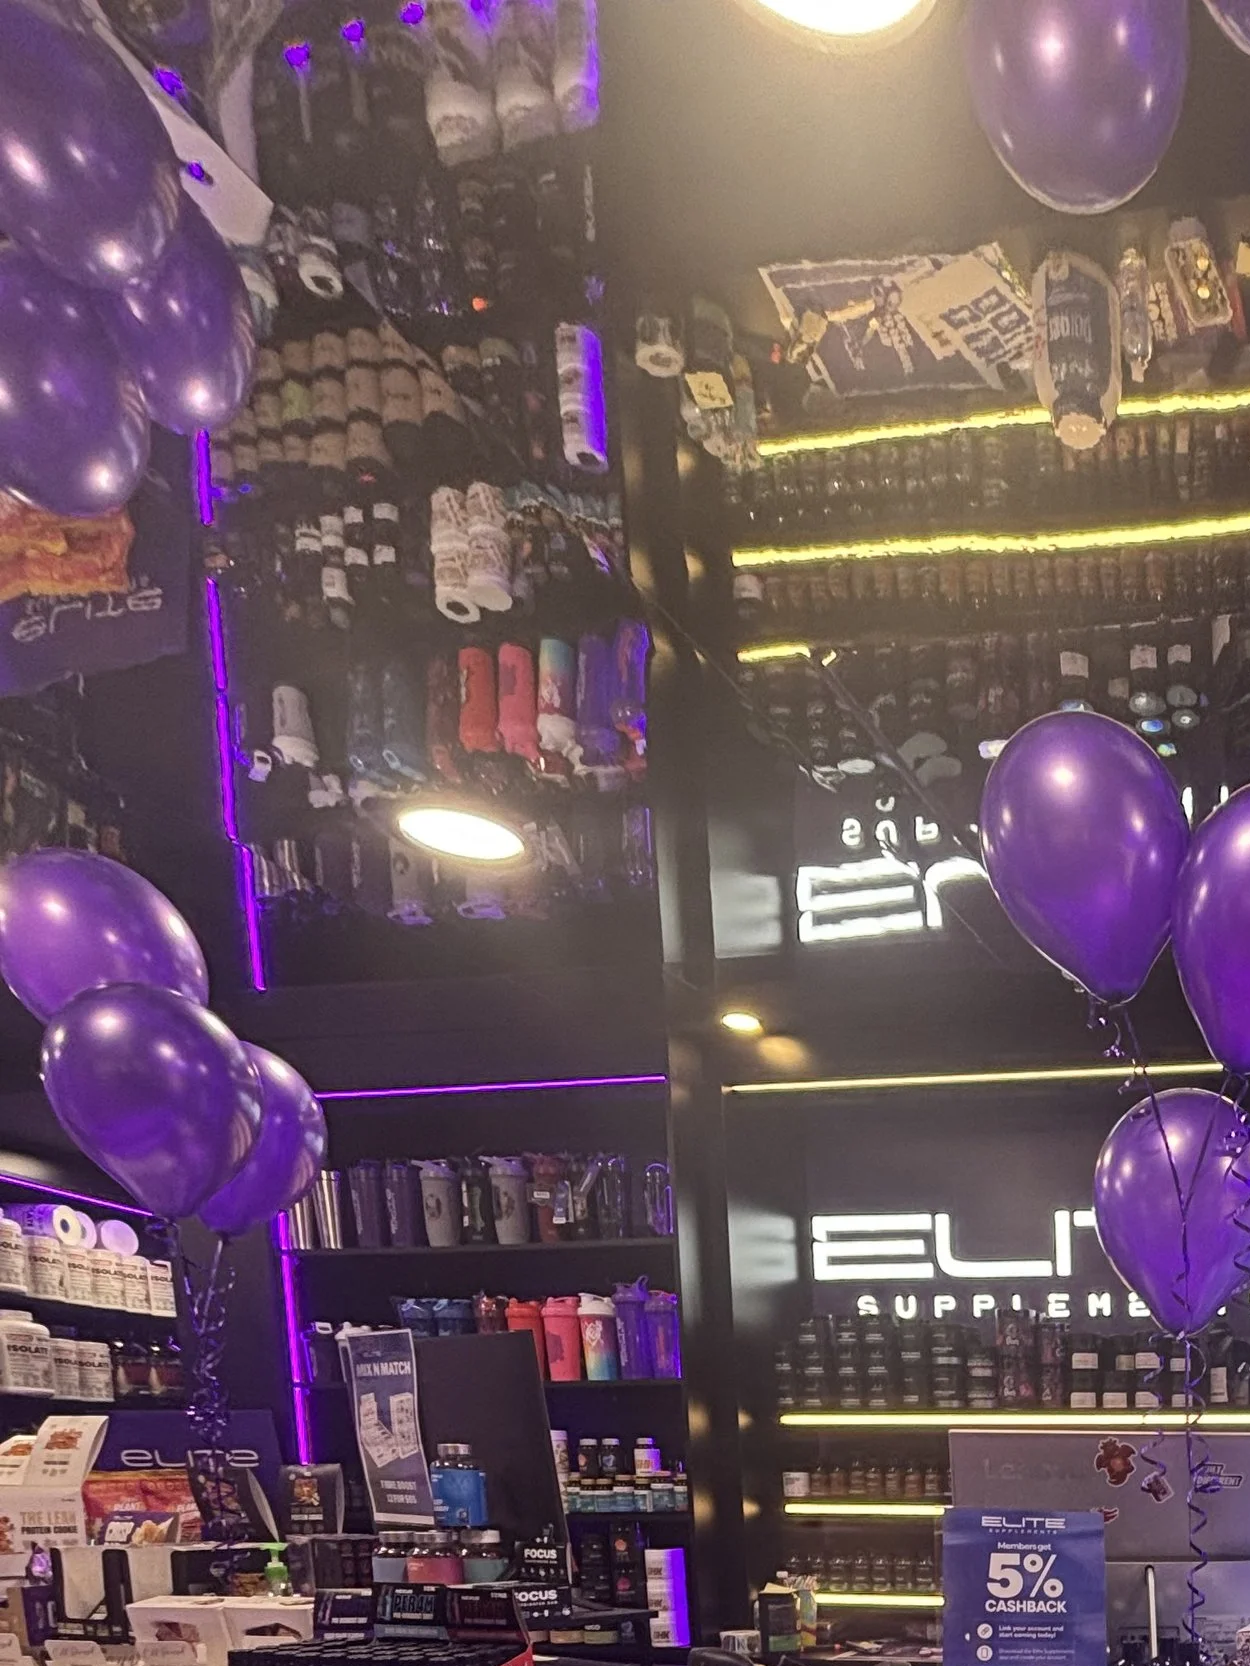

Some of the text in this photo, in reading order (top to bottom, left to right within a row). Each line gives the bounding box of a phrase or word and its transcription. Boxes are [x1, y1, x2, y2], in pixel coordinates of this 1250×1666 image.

[381, 1360, 411, 1376] MATCH
[981, 1516, 1066, 1529] ELITE
[997, 1542, 1052, 1552] Members get
[524, 1548, 557, 1560] FOCUS
[986, 1552, 1064, 1599] 5%
[985, 1600, 1068, 1614] CASHBACK
